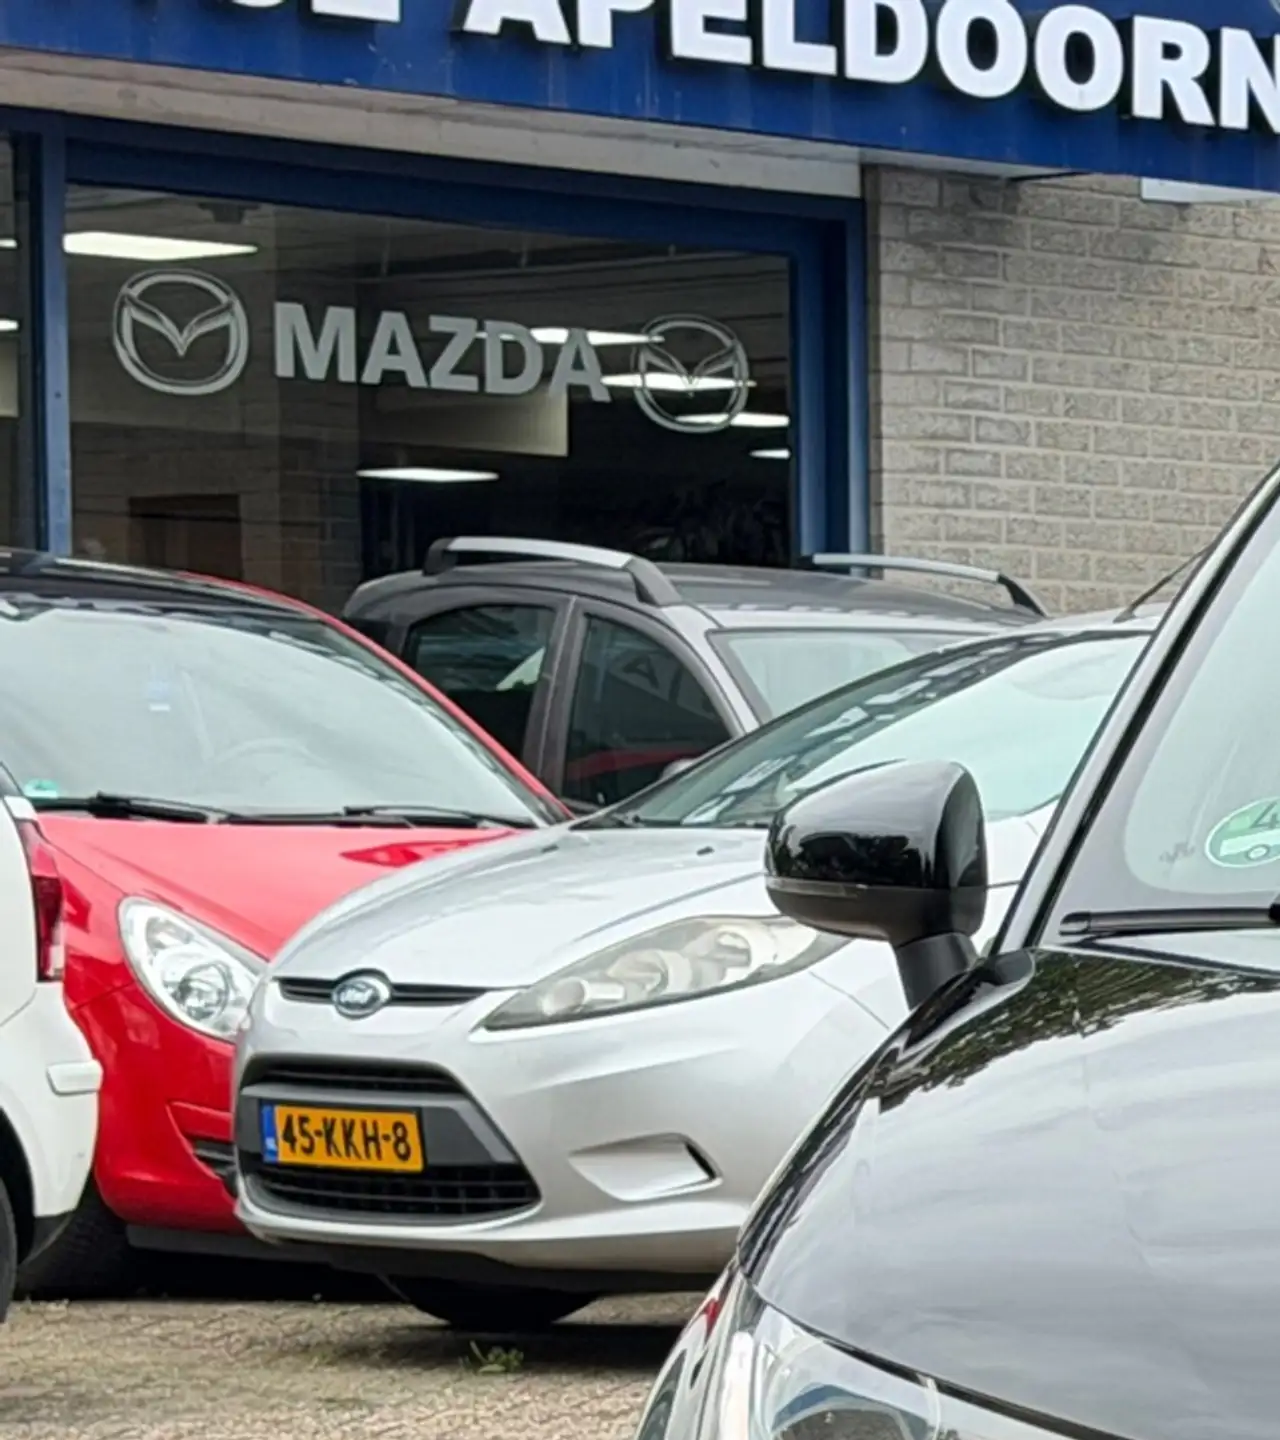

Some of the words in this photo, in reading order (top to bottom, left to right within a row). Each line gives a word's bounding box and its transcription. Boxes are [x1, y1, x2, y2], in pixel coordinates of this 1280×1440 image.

[274, 302, 612, 403] MAZDA
[1249, 802, 1280, 829] 4
[282, 1113, 412, 1162] 45-KKH-8
